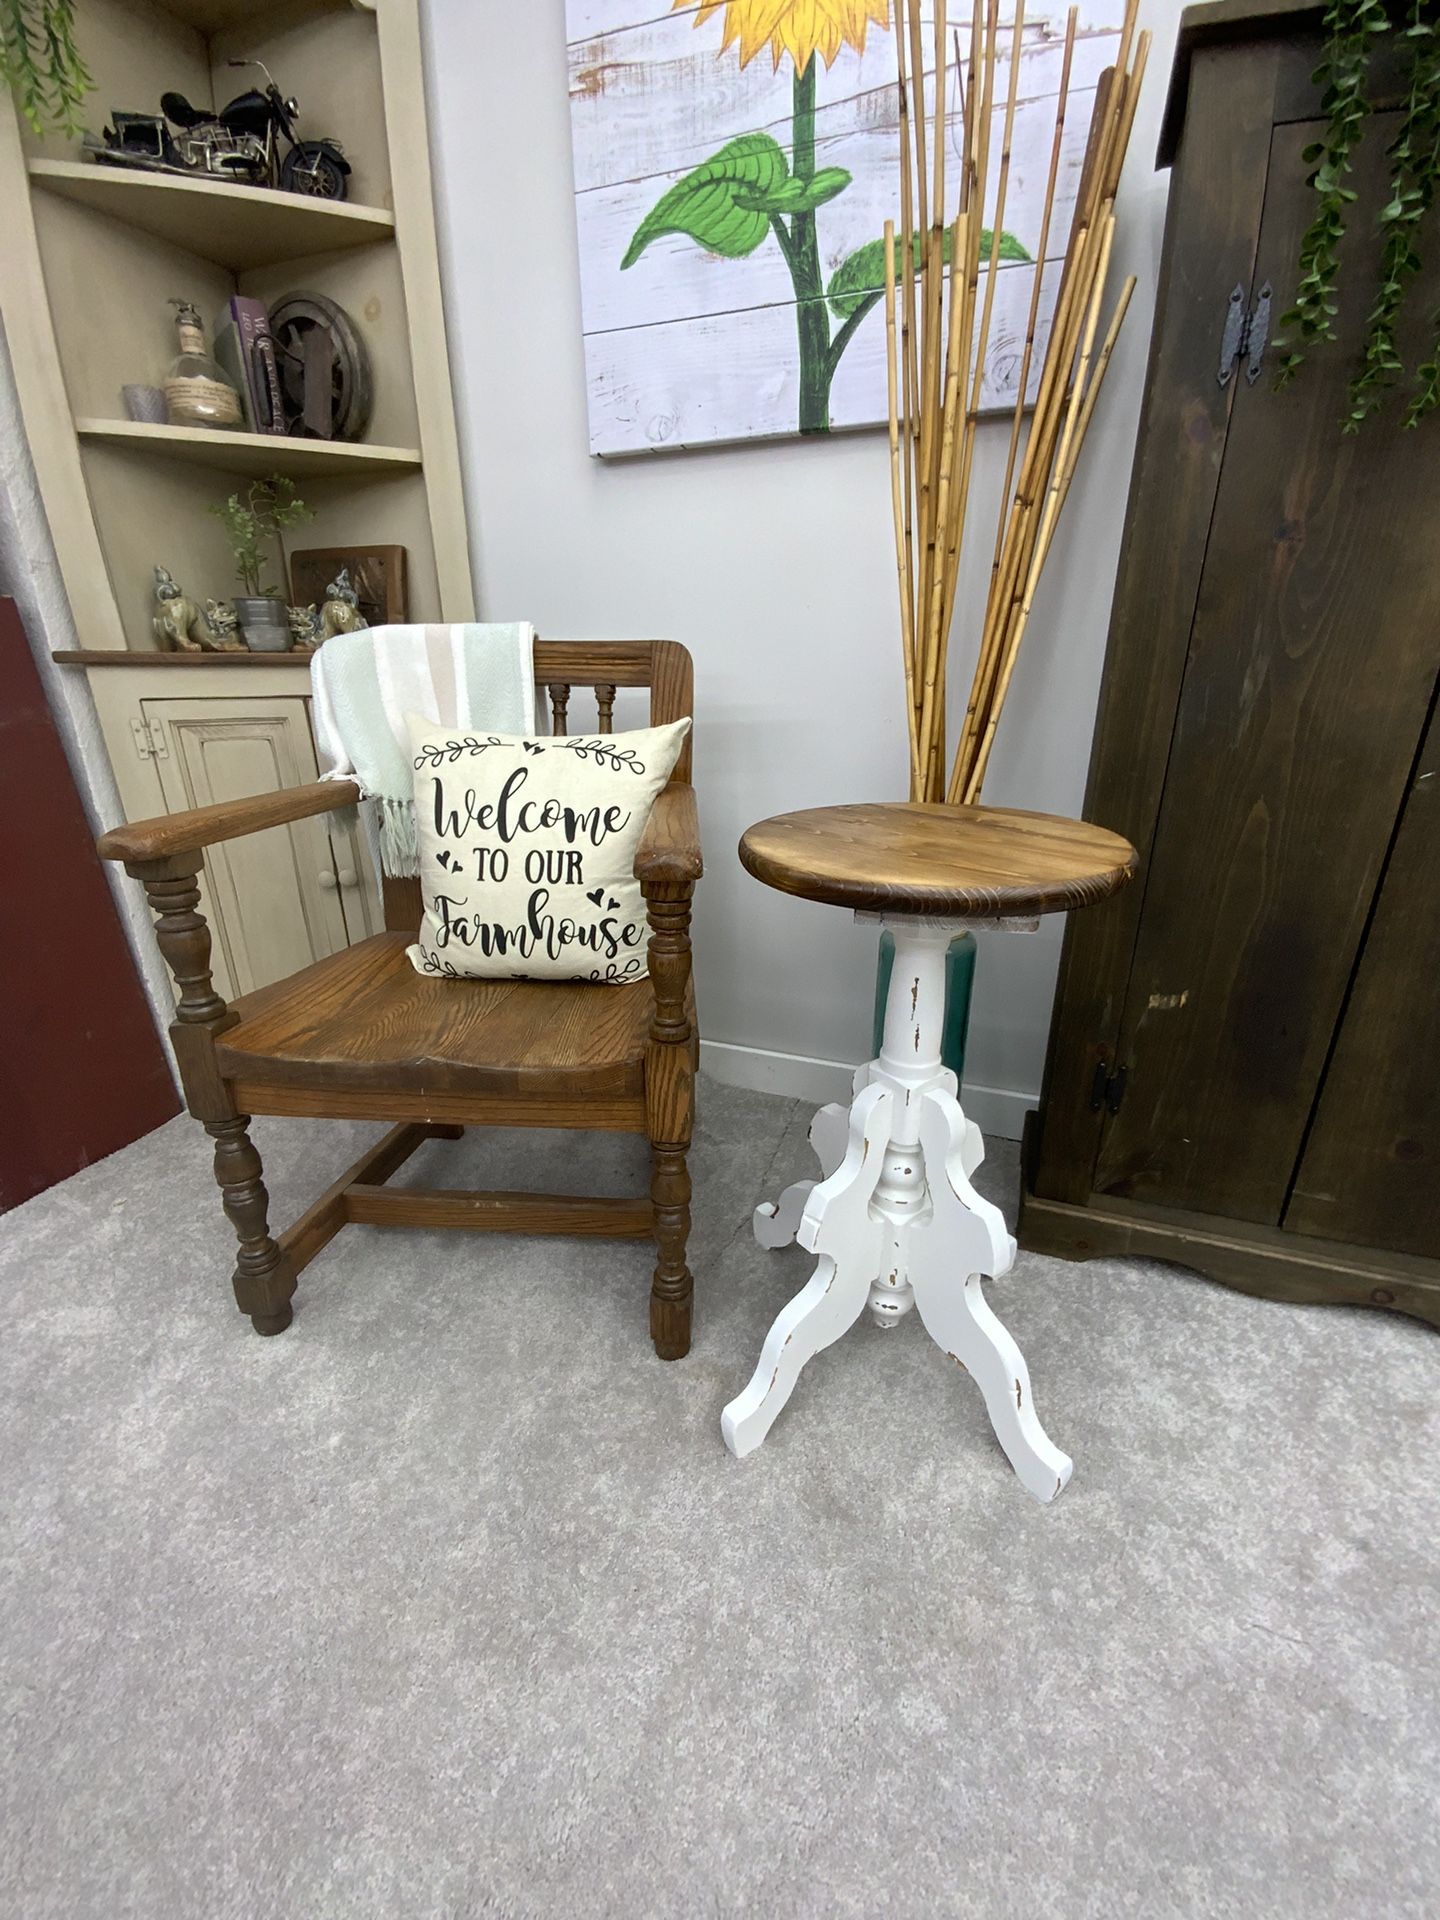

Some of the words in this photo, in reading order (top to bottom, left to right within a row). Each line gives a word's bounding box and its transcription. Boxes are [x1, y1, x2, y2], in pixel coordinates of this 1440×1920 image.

[242, 311, 252, 331] LEO
[270, 391, 285, 432] PEACE
[431, 767, 632, 847] Welcome
[472, 847, 509, 882] TO
[524, 849, 584, 885] OUR
[433, 888, 644, 960] Farmhouse
